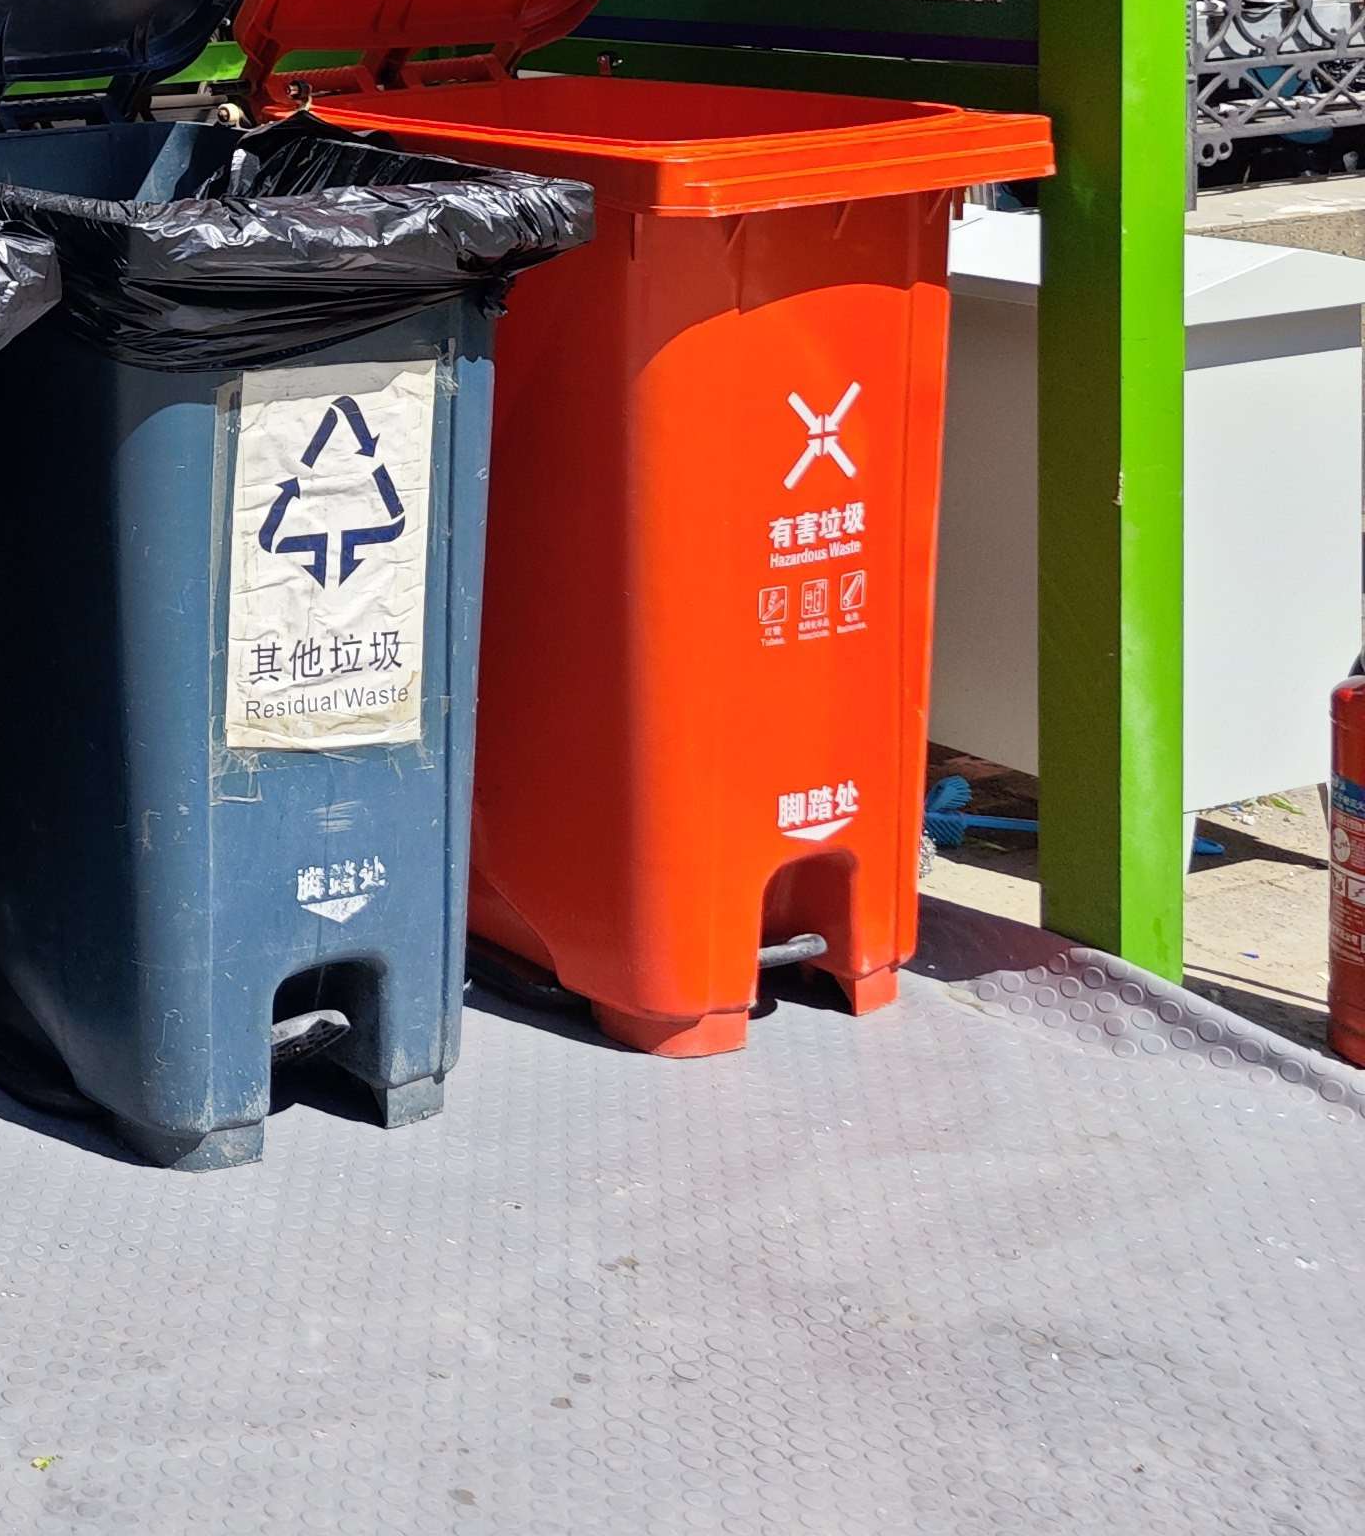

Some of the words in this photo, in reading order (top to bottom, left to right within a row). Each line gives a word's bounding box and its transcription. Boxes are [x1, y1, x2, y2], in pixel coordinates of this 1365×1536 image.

[769, 501, 865, 549] 有害垃圾
[770, 548, 828, 568] Hazardous
[829, 539, 862, 558] Waste
[249, 630, 403, 685] 其他垃圾
[246, 692, 338, 721] Residual
[345, 686, 409, 709] Waste
[777, 780, 860, 828] 脚踏处
